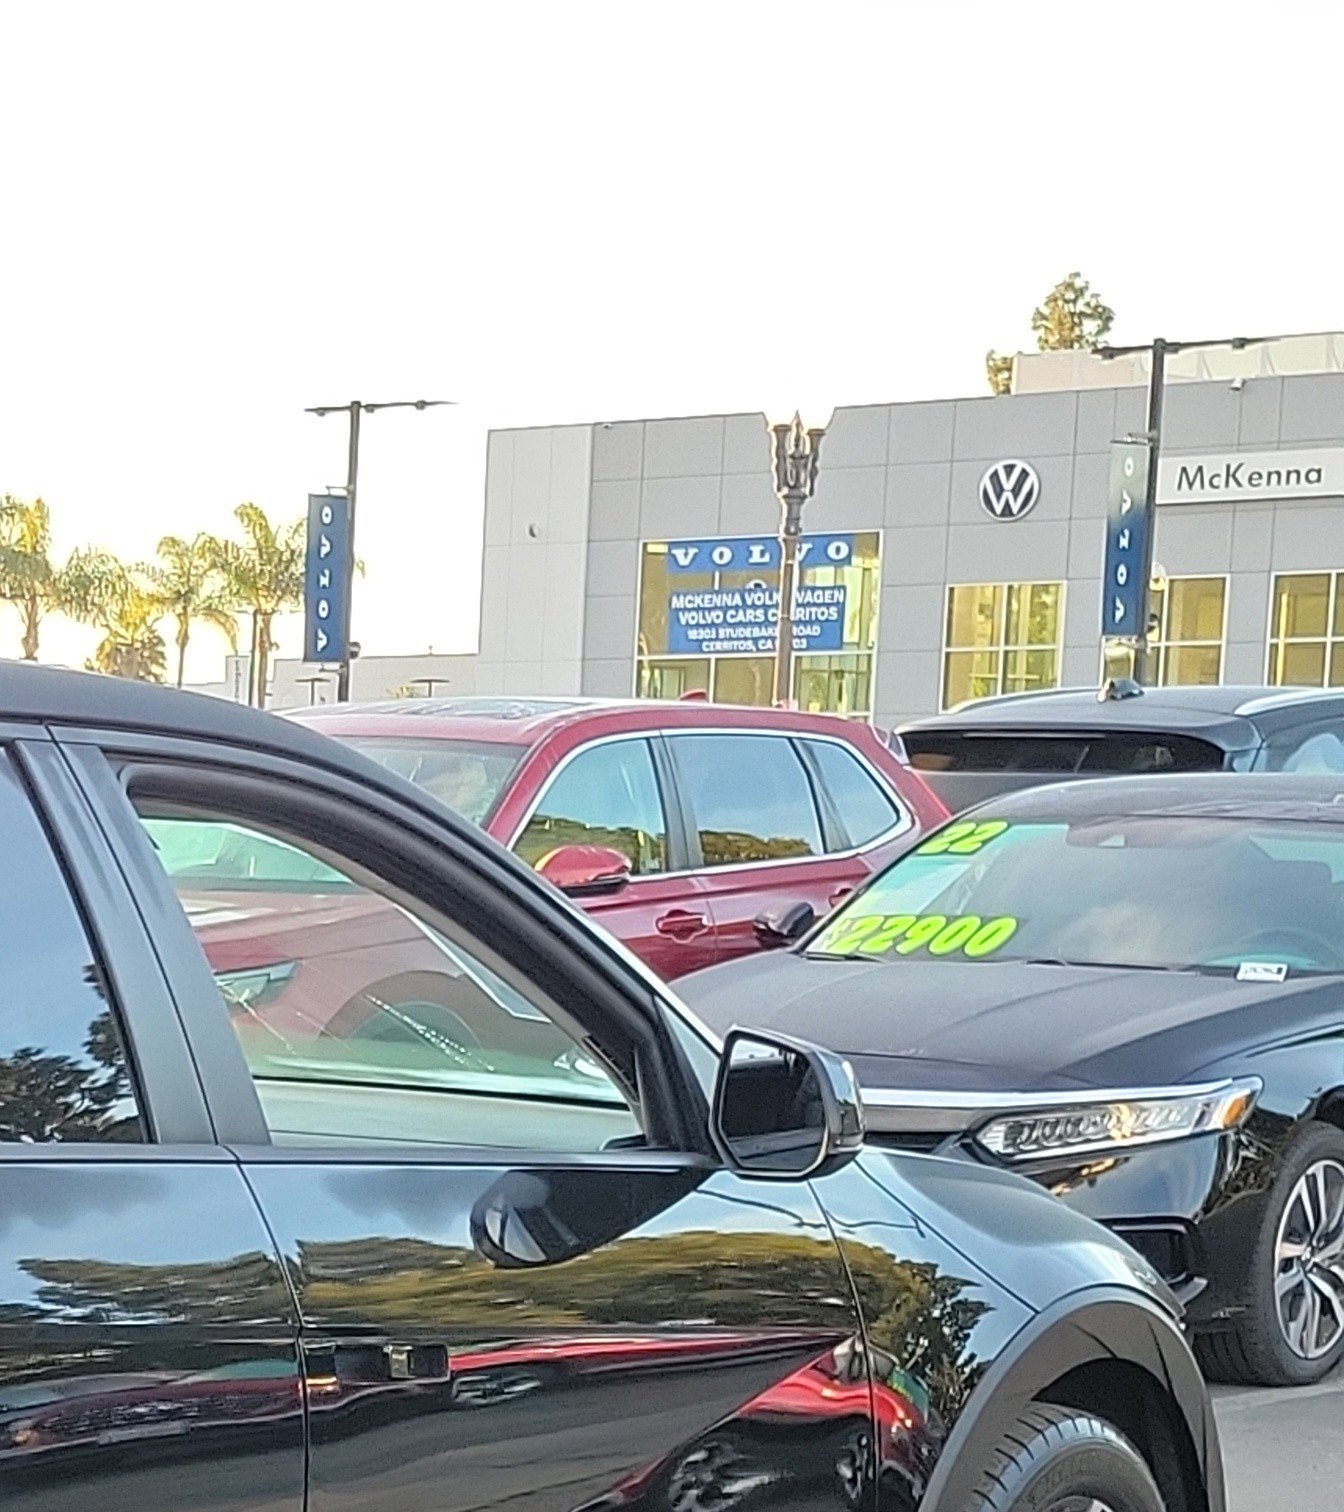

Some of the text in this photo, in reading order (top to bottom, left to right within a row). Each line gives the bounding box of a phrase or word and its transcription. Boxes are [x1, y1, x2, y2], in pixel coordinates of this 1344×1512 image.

[1177, 462, 1322, 492] McKenna
[1113, 456, 1134, 624] VOLVO
[316, 505, 333, 652] VOLVO
[671, 592, 743, 609] MCKENNA
[678, 610, 724, 626] VOLVO
[725, 608, 765, 623] CARS
[915, 820, 1008, 856] 22
